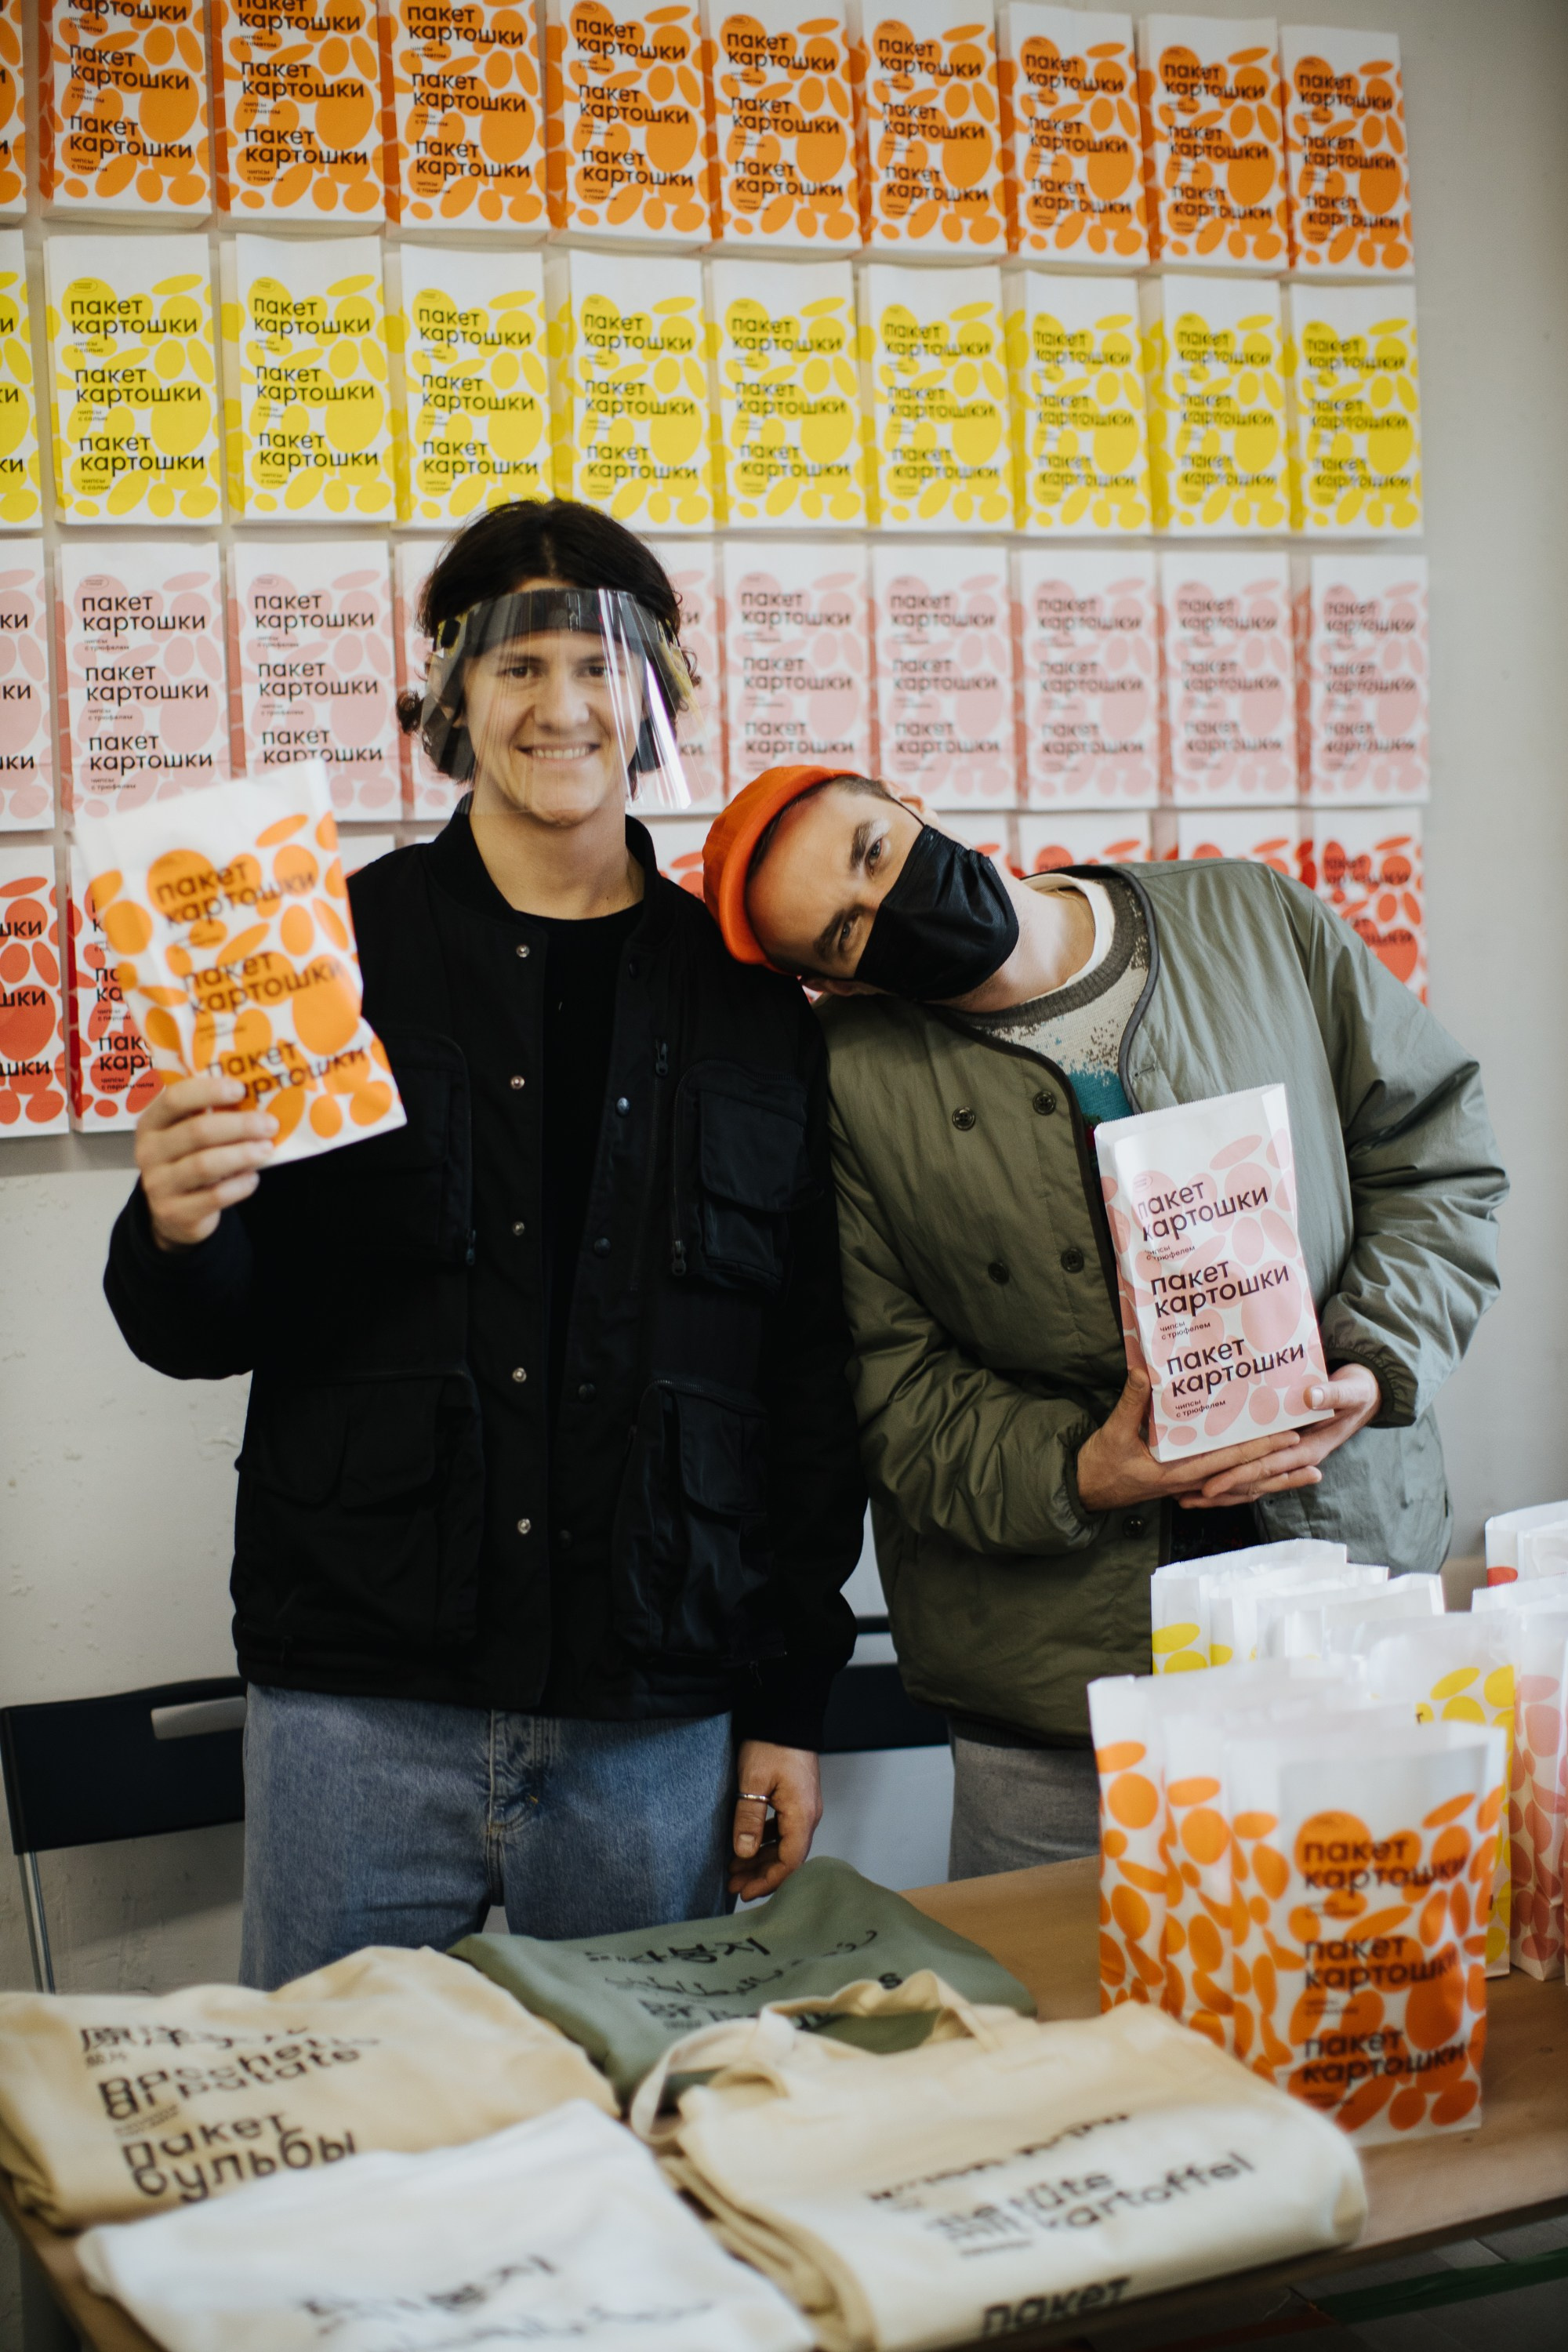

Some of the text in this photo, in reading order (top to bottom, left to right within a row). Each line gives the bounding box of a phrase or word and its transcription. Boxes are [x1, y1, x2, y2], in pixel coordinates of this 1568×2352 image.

[68, 0, 187, 20] картошки
[238, 0, 306, 11] пакет
[408, 6, 474, 23] пакет
[239, 13, 360, 35] картошки
[575, 18, 637, 39] пакет
[409, 26, 523, 45] картошки
[726, 32, 789, 51] пакет
[70, 44, 136, 67] пакет
[577, 38, 685, 60] картошки
[878, 38, 935, 57] пакет
[241, 61, 310, 78] пакет
[728, 51, 835, 71] картошки
[880, 57, 981, 77] картошки
[1025, 53, 1079, 73] пакет
[71, 64, 189, 89] картошки
[412, 73, 477, 90] пакет
[1027, 72, 1123, 92] картошки
[242, 81, 364, 102] картошки
[579, 83, 641, 103] пакет
[413, 93, 525, 112] картошки
[731, 96, 792, 114] пакет
[881, 102, 938, 120] пакет
[580, 103, 689, 123] картошки
[71, 115, 138, 136] пакет
[732, 114, 839, 135] картошки
[884, 120, 985, 140] картошки
[1028, 115, 1083, 135] пакет
[245, 129, 314, 144] пакет
[1029, 134, 1127, 154] картошки
[71, 136, 191, 158] картошки
[416, 140, 479, 158] пакет
[581, 148, 645, 166] пакет
[246, 148, 367, 169] картошки
[734, 159, 795, 178] пакет
[417, 159, 530, 181] картошки
[583, 167, 693, 188] картошки
[884, 165, 942, 183] пакет
[736, 179, 843, 198] картошки
[887, 184, 989, 203] картошки
[1031, 177, 1087, 195] пакет
[1033, 196, 1131, 215] картошки
[71, 300, 142, 314] пакет
[255, 298, 317, 314] пакет
[419, 308, 479, 325] пакет
[584, 313, 644, 332] пакет
[731, 317, 792, 335] пакет
[72, 319, 197, 339] картошки
[255, 318, 370, 338] картошки
[420, 327, 531, 348] картошки
[585, 333, 691, 354] картошки
[732, 337, 841, 356] картошки
[75, 368, 146, 383] пакет
[256, 365, 321, 382] пакет
[422, 374, 483, 391] пакет
[76, 387, 201, 408] картошки
[256, 385, 374, 405] картошки
[584, 379, 647, 397] пакет
[734, 380, 797, 397] пакет
[423, 393, 534, 415] картошки
[585, 398, 695, 419] картошки
[736, 399, 845, 419] картошки
[79, 437, 151, 452] пакет
[260, 433, 325, 448] пакет
[423, 441, 488, 456] пакет
[586, 444, 650, 461] пакет
[739, 443, 801, 460] пакет
[81, 456, 204, 477] картошки
[260, 452, 378, 472] картошки
[424, 459, 538, 480] картошки
[742, 463, 851, 481] картошки
[588, 464, 698, 483] картошки
[82, 597, 152, 612] пакет
[255, 595, 321, 609] пакет
[741, 591, 803, 608] пакет
[83, 615, 205, 637] картошки
[256, 613, 374, 634] картошки
[742, 611, 851, 630] картошки
[85, 666, 155, 681] пакет
[259, 662, 325, 677] пакет
[742, 656, 805, 673] пакет
[260, 681, 377, 702] картошки
[744, 675, 852, 694] картошки
[87, 684, 208, 706] картошки
[263, 730, 328, 745] пакет
[745, 720, 807, 736] пакет
[89, 735, 158, 751] пакет
[746, 740, 854, 759] картошки
[90, 754, 212, 776] картошки
[156, 862, 248, 902] пакет
[166, 873, 314, 928] картошки
[183, 953, 272, 991] пакет
[191, 962, 343, 1015] картошки
[207, 1044, 298, 1078] пакет
[245, 1047, 366, 1103] ртошки
[1138, 1181, 1203, 1220] пакет
[1143, 1186, 1268, 1242] картошки
[1151, 1261, 1230, 1295] пакет
[1155, 1265, 1290, 1318] картошки
[1160, 1321, 1185, 1331] чипсы
[1168, 1322, 1211, 1339] трюфелем
[1167, 1338, 1245, 1375] пакет
[1172, 1343, 1305, 1397] картошки
[1175, 1399, 1201, 1410] чипсы
[1183, 1400, 1226, 1417] трюфелем
[1305, 1840, 1407, 1863] пакет
[1305, 1856, 1467, 1898] картошки
[1305, 1936, 1406, 1962] пакет
[1305, 2030, 1403, 2060] пакет
[1303, 2042, 1466, 2089] картошки
